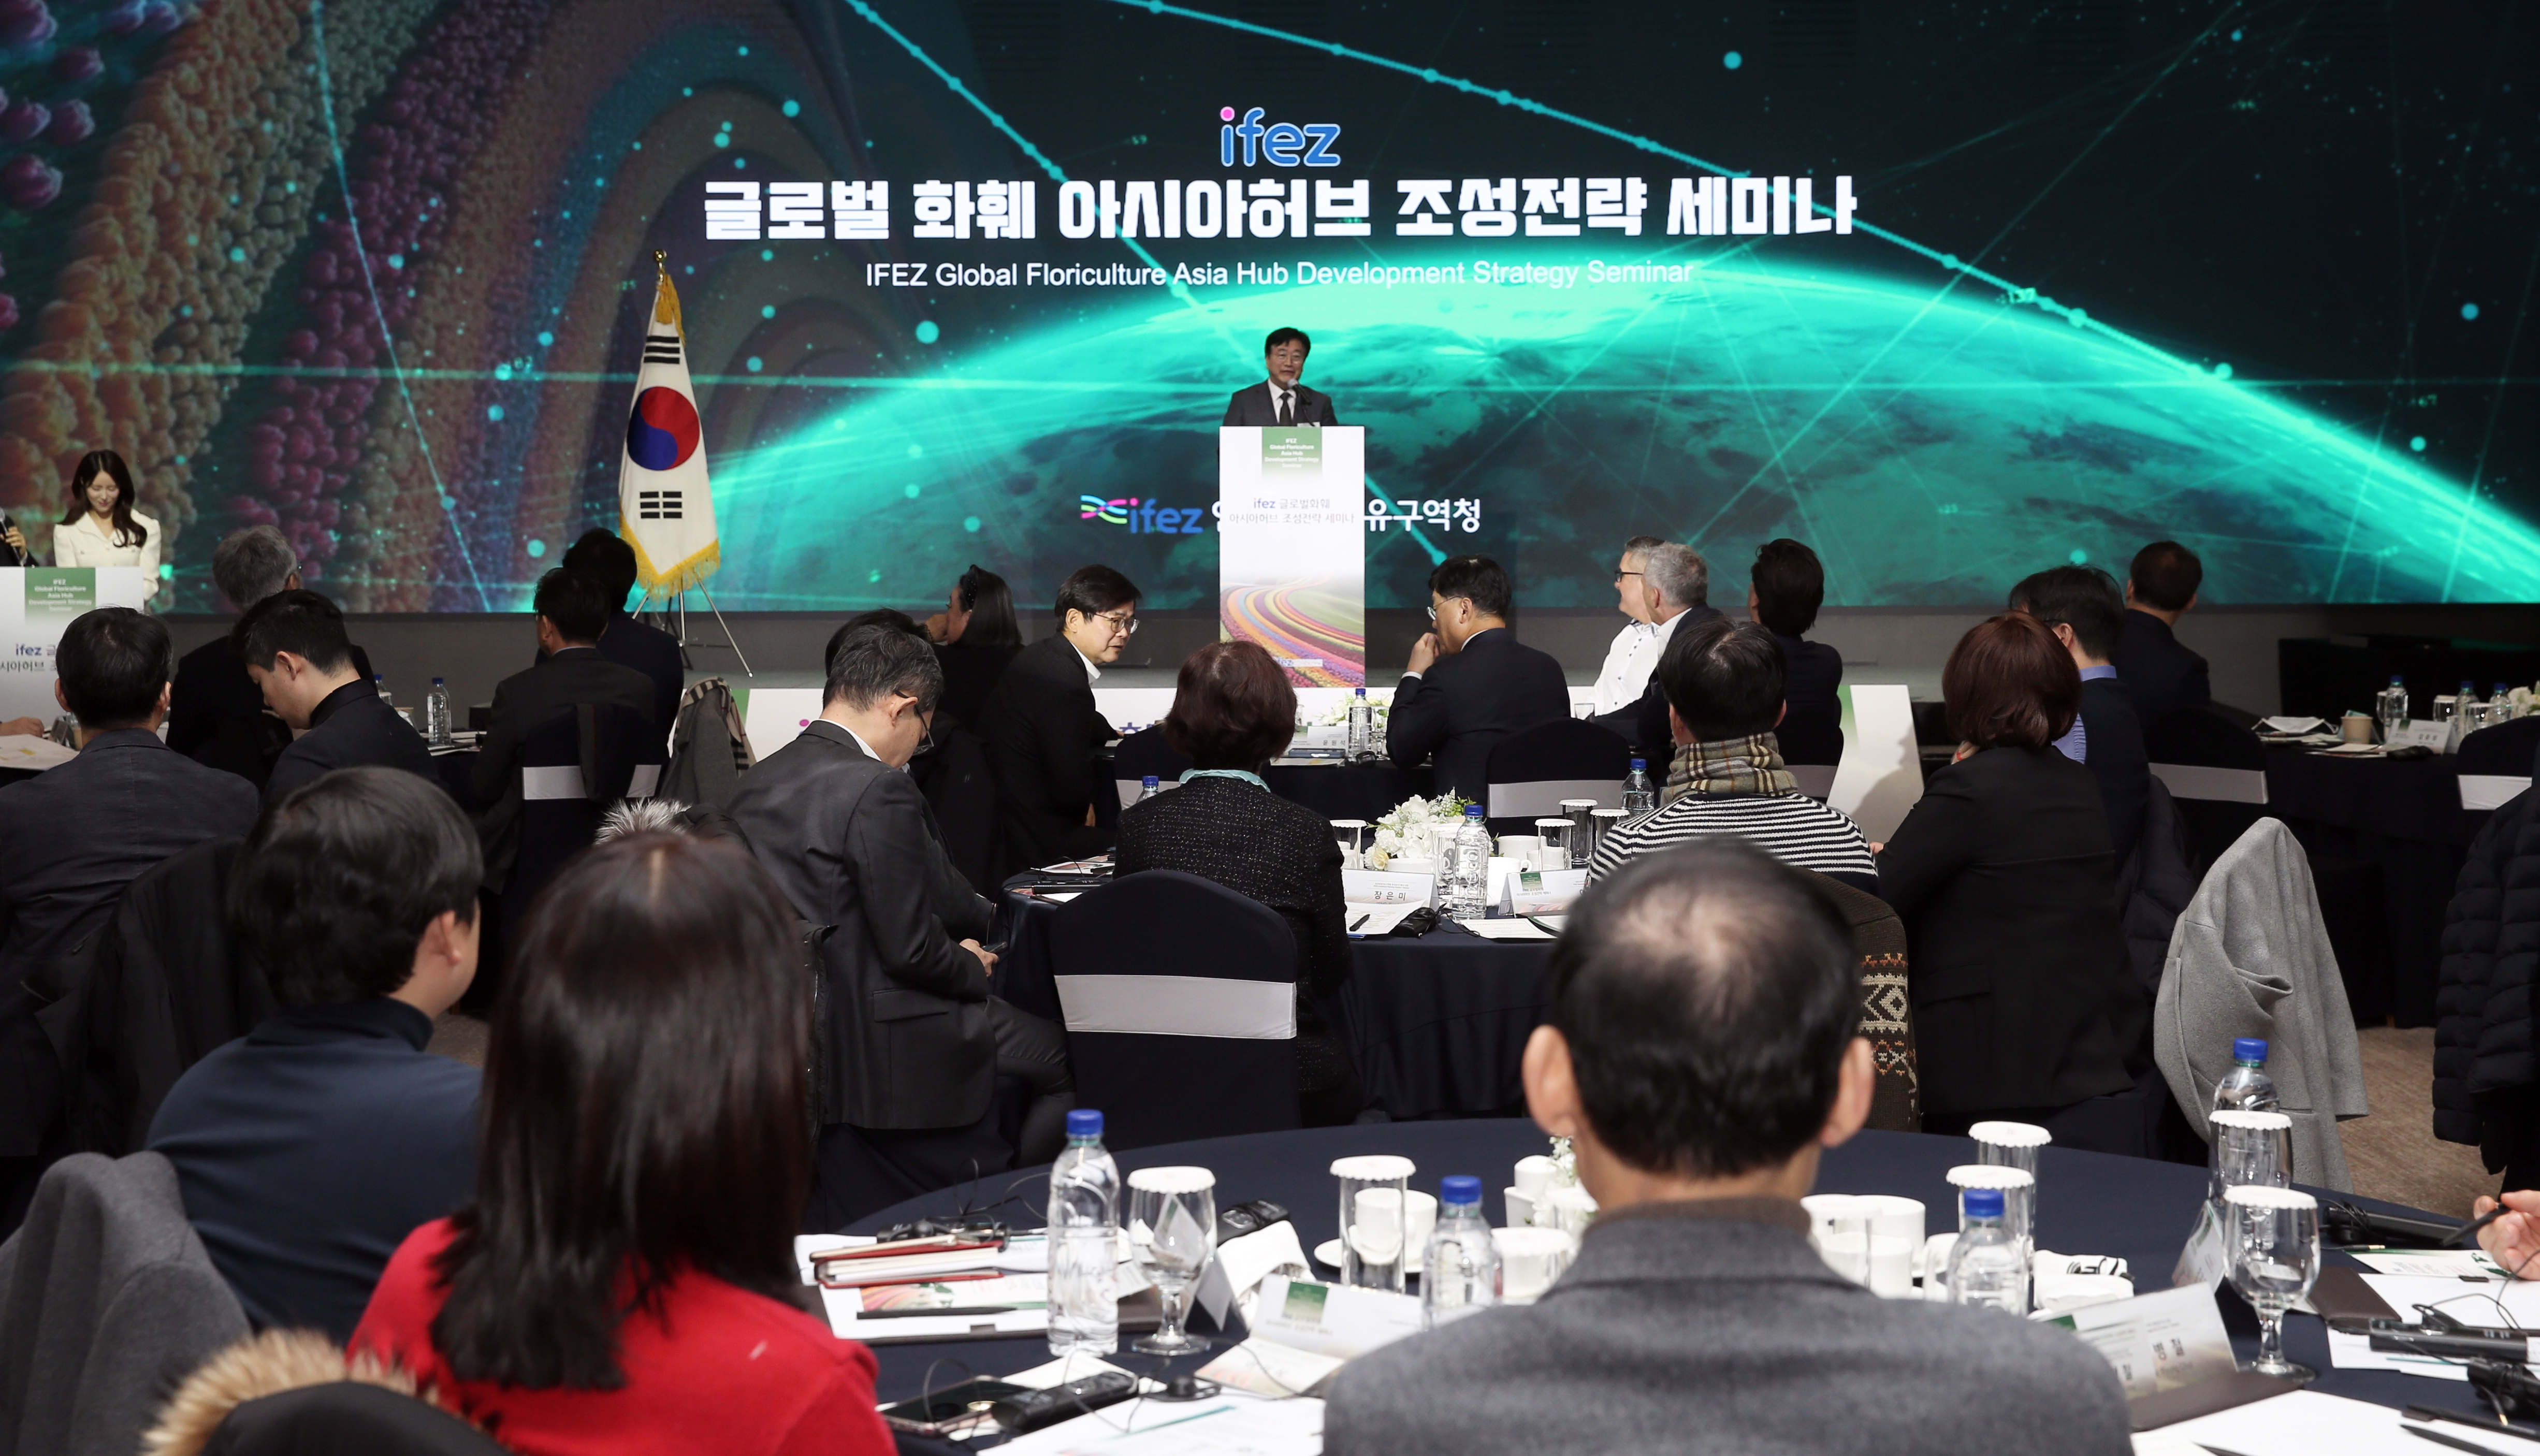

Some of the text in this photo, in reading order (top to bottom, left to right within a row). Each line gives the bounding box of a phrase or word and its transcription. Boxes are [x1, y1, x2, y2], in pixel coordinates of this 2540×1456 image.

[1220, 106, 1341, 167] ifez
[705, 176, 1857, 240] 글로벌 화훼 아시아허브 조성전략 세미나
[866, 260, 1693, 288] IFEZ Global Floriculture Asia Hub Development Strategy Seminar
[1129, 498, 1204, 534] ifez
[1254, 498, 1275, 508] ifez
[1229, 513, 1354, 524] 아시아허브 조성전략 세미나
[16, 643, 42, 656] ifez
